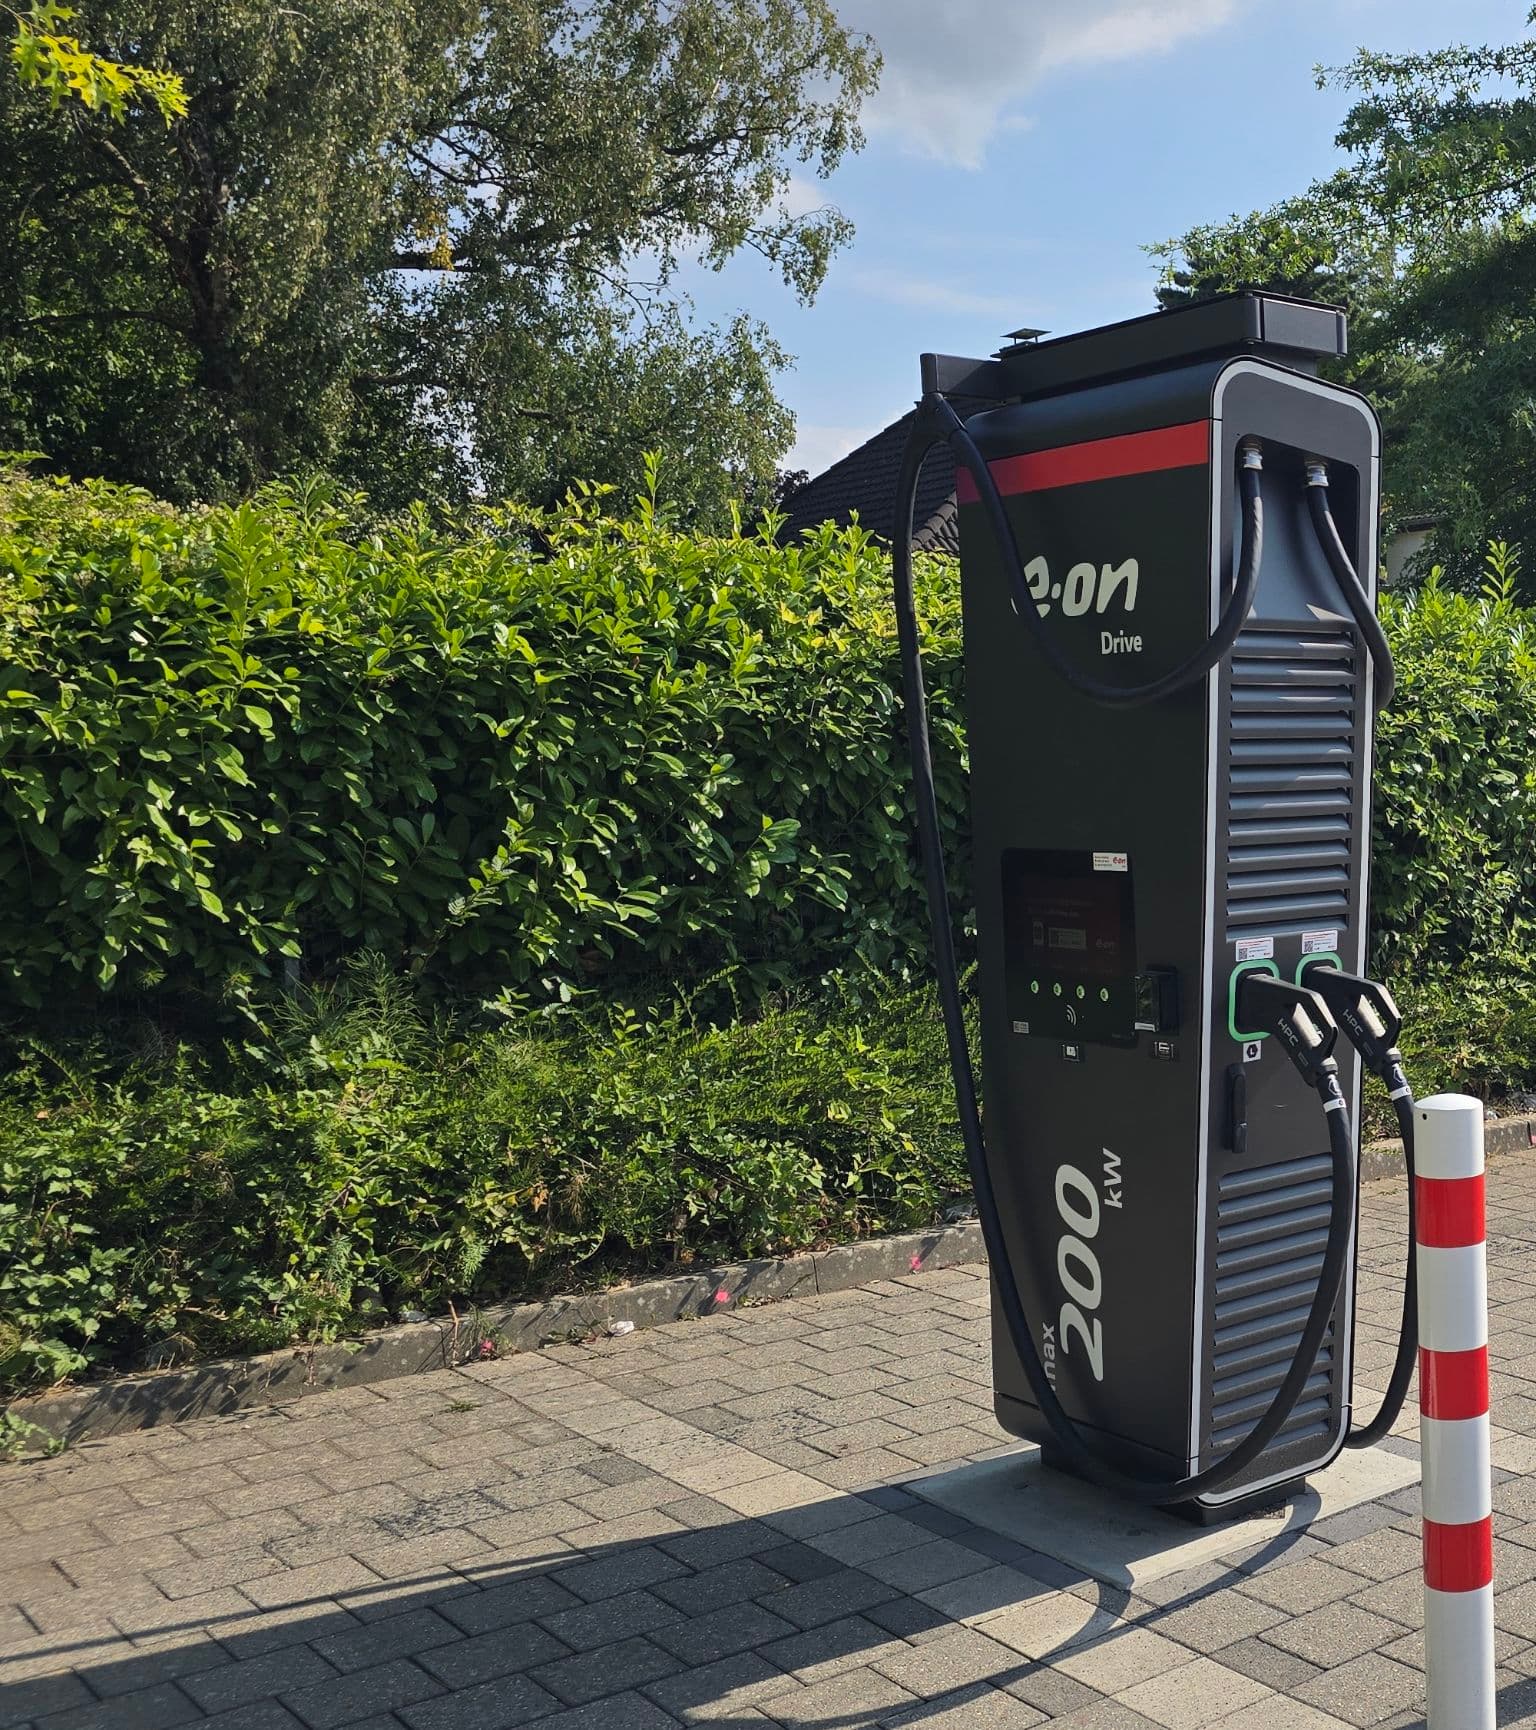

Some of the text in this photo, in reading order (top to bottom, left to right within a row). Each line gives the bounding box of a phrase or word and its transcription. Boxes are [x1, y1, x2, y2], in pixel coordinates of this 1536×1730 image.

[1100, 629, 1143, 655] Drive
[1277, 1017, 1299, 1047] HPC
[1342, 1008, 1364, 1036] HPC
[1055, 1163, 1104, 1381] 200
[1102, 1147, 1123, 1209] kW
